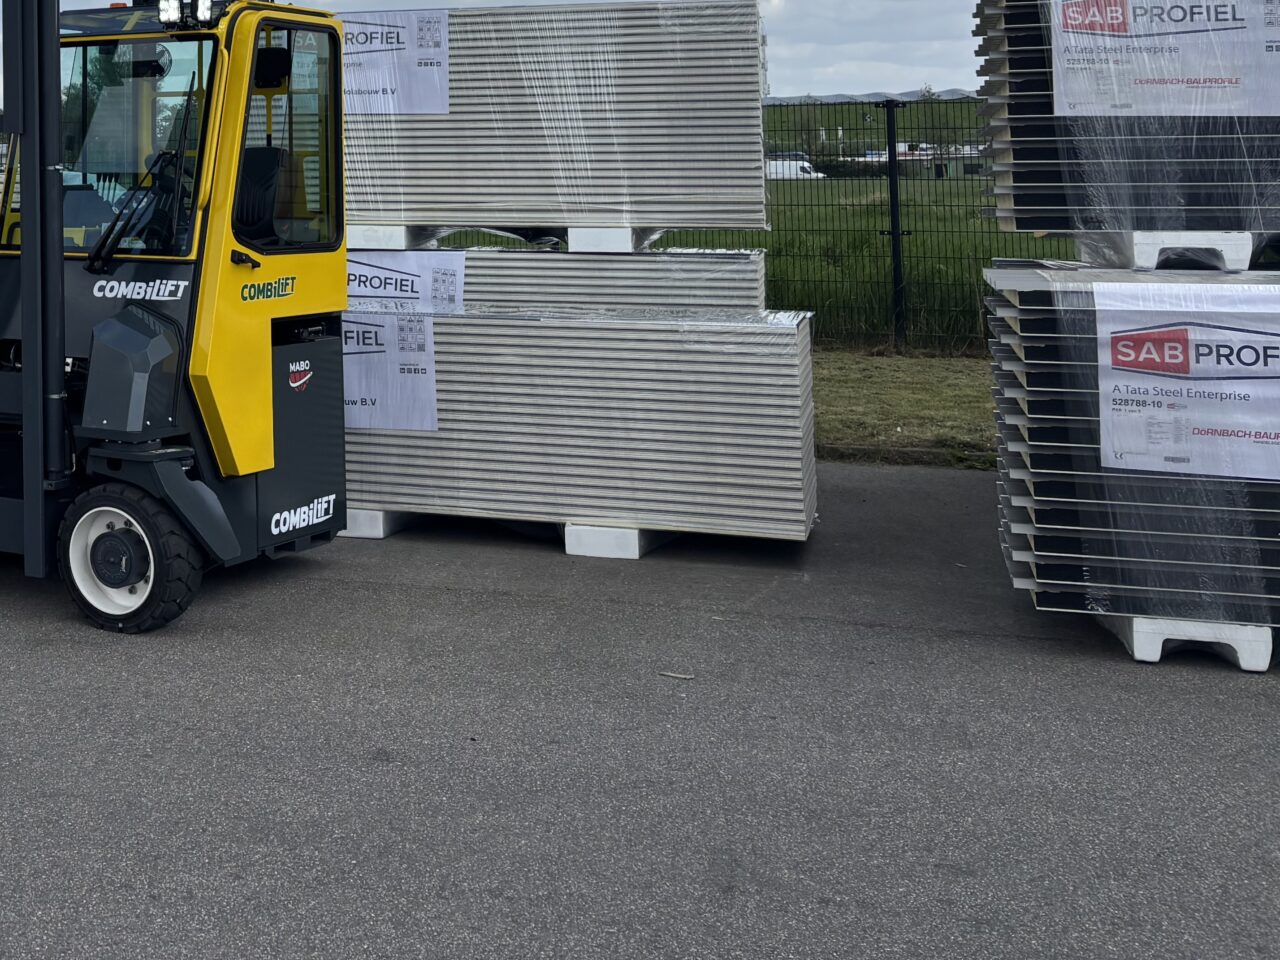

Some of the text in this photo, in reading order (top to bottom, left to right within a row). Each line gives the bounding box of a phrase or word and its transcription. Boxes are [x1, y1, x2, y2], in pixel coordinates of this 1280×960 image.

[1066, 4, 1245, 24] SAB PROFIEL
[344, 31, 406, 46] ROFIEL
[1073, 45, 1094, 54] Tata
[1096, 45, 1123, 54] Steel
[1125, 45, 1180, 55] Enterprise
[347, 273, 419, 294] PROFIEL
[343, 330, 385, 346] FIEL
[1117, 341, 1184, 364] SAB
[289, 360, 310, 372] MABO
[1112, 384, 1251, 402] A Tata Steel Enterprise
[1112, 398, 1163, 409] 528788-10
